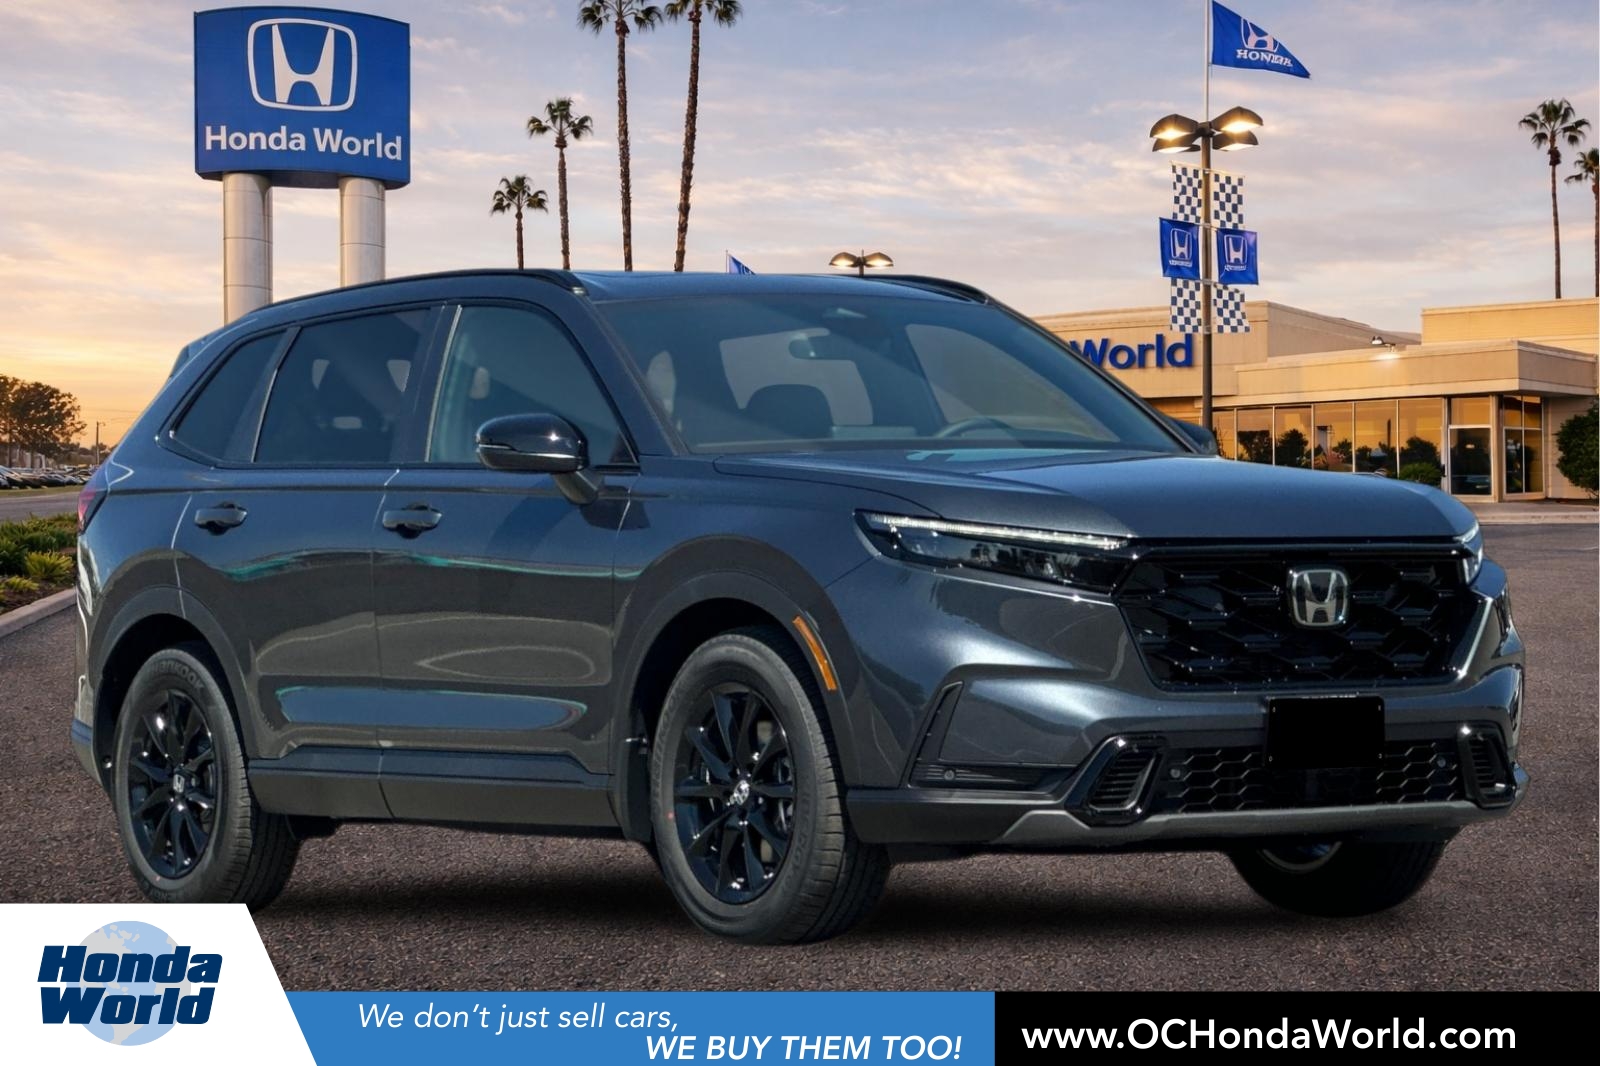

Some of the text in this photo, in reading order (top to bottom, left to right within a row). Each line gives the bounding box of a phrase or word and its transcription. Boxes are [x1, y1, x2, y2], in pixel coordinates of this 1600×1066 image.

[205, 125, 402, 160] Honda World
[1069, 333, 1194, 369] World
